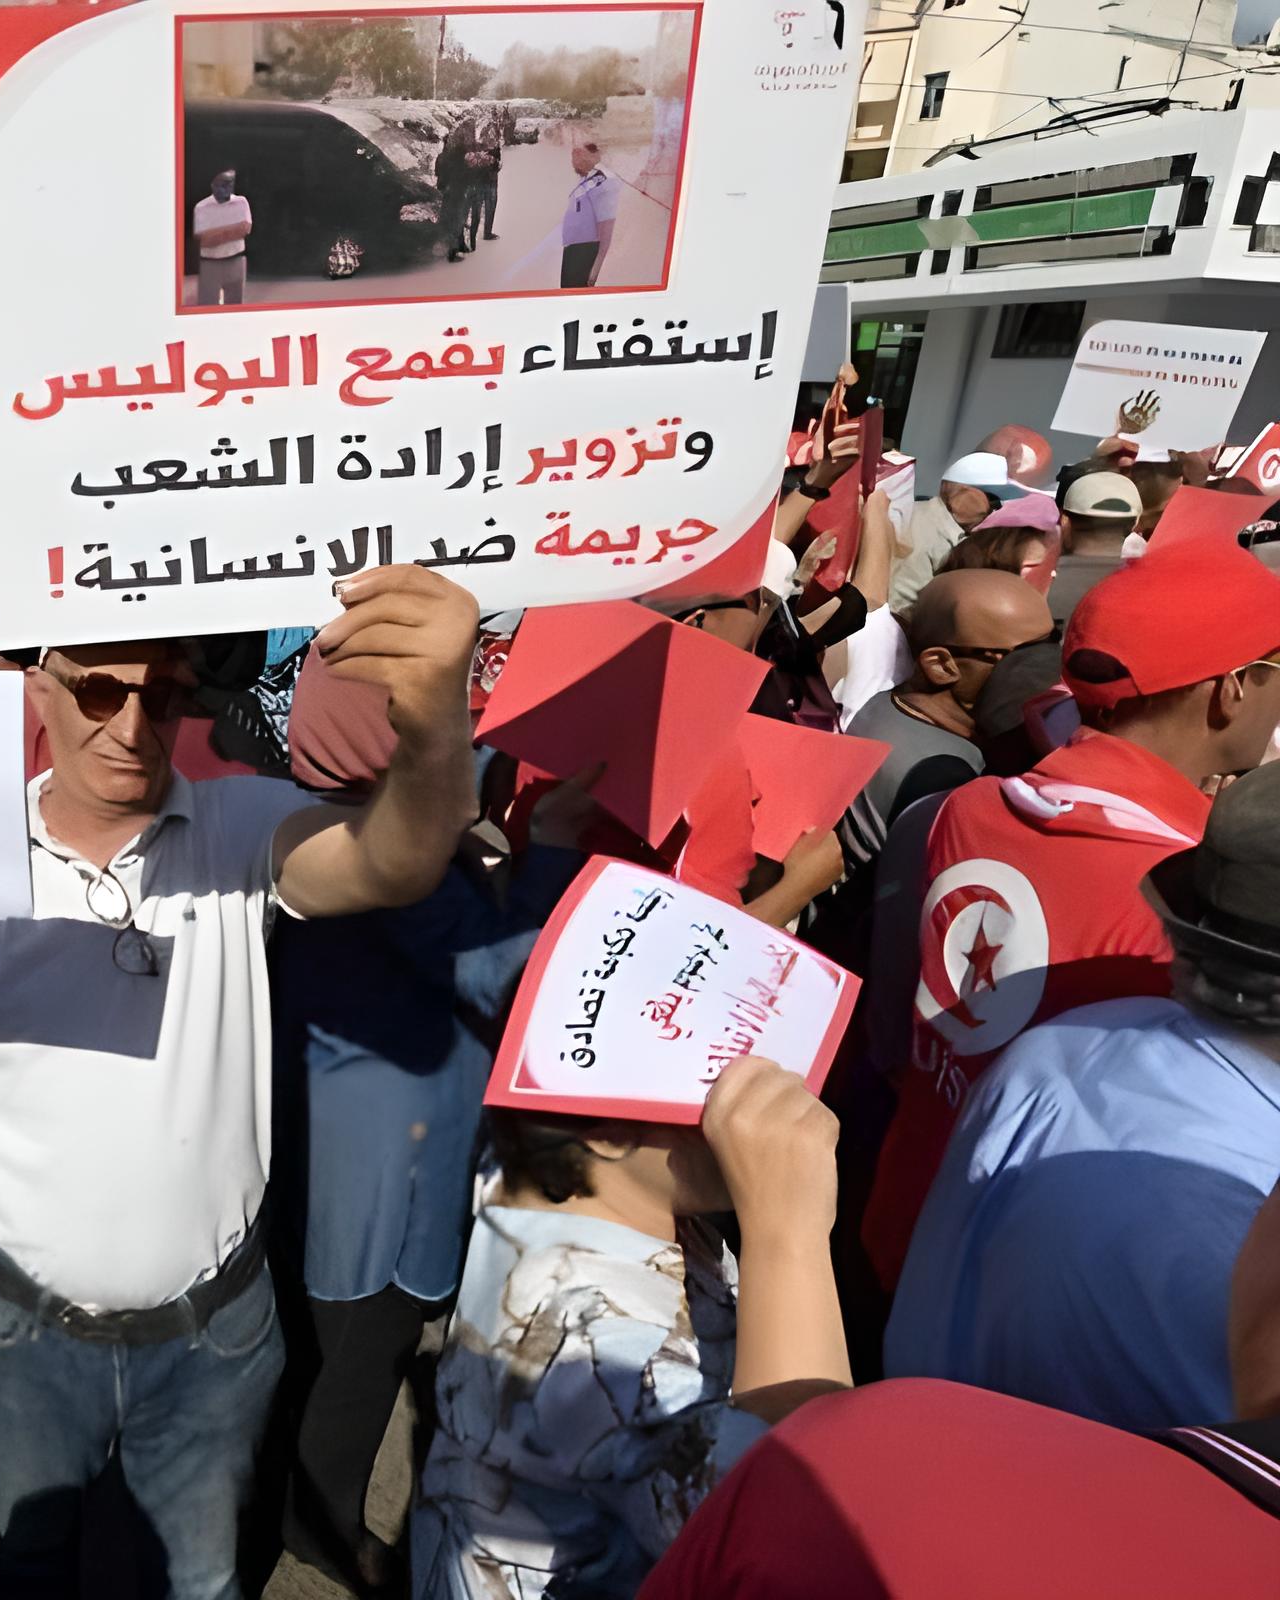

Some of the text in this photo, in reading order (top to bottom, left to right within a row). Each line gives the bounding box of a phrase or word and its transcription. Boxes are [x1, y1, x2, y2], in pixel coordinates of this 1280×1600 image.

[13, 309, 778, 420] إستفتاء بقمع البوليس
[70, 417, 714, 510] وتزوير إرادة الشعب
[413, 516, 517, 568] ضد
[534, 511, 719, 566] جريمة
